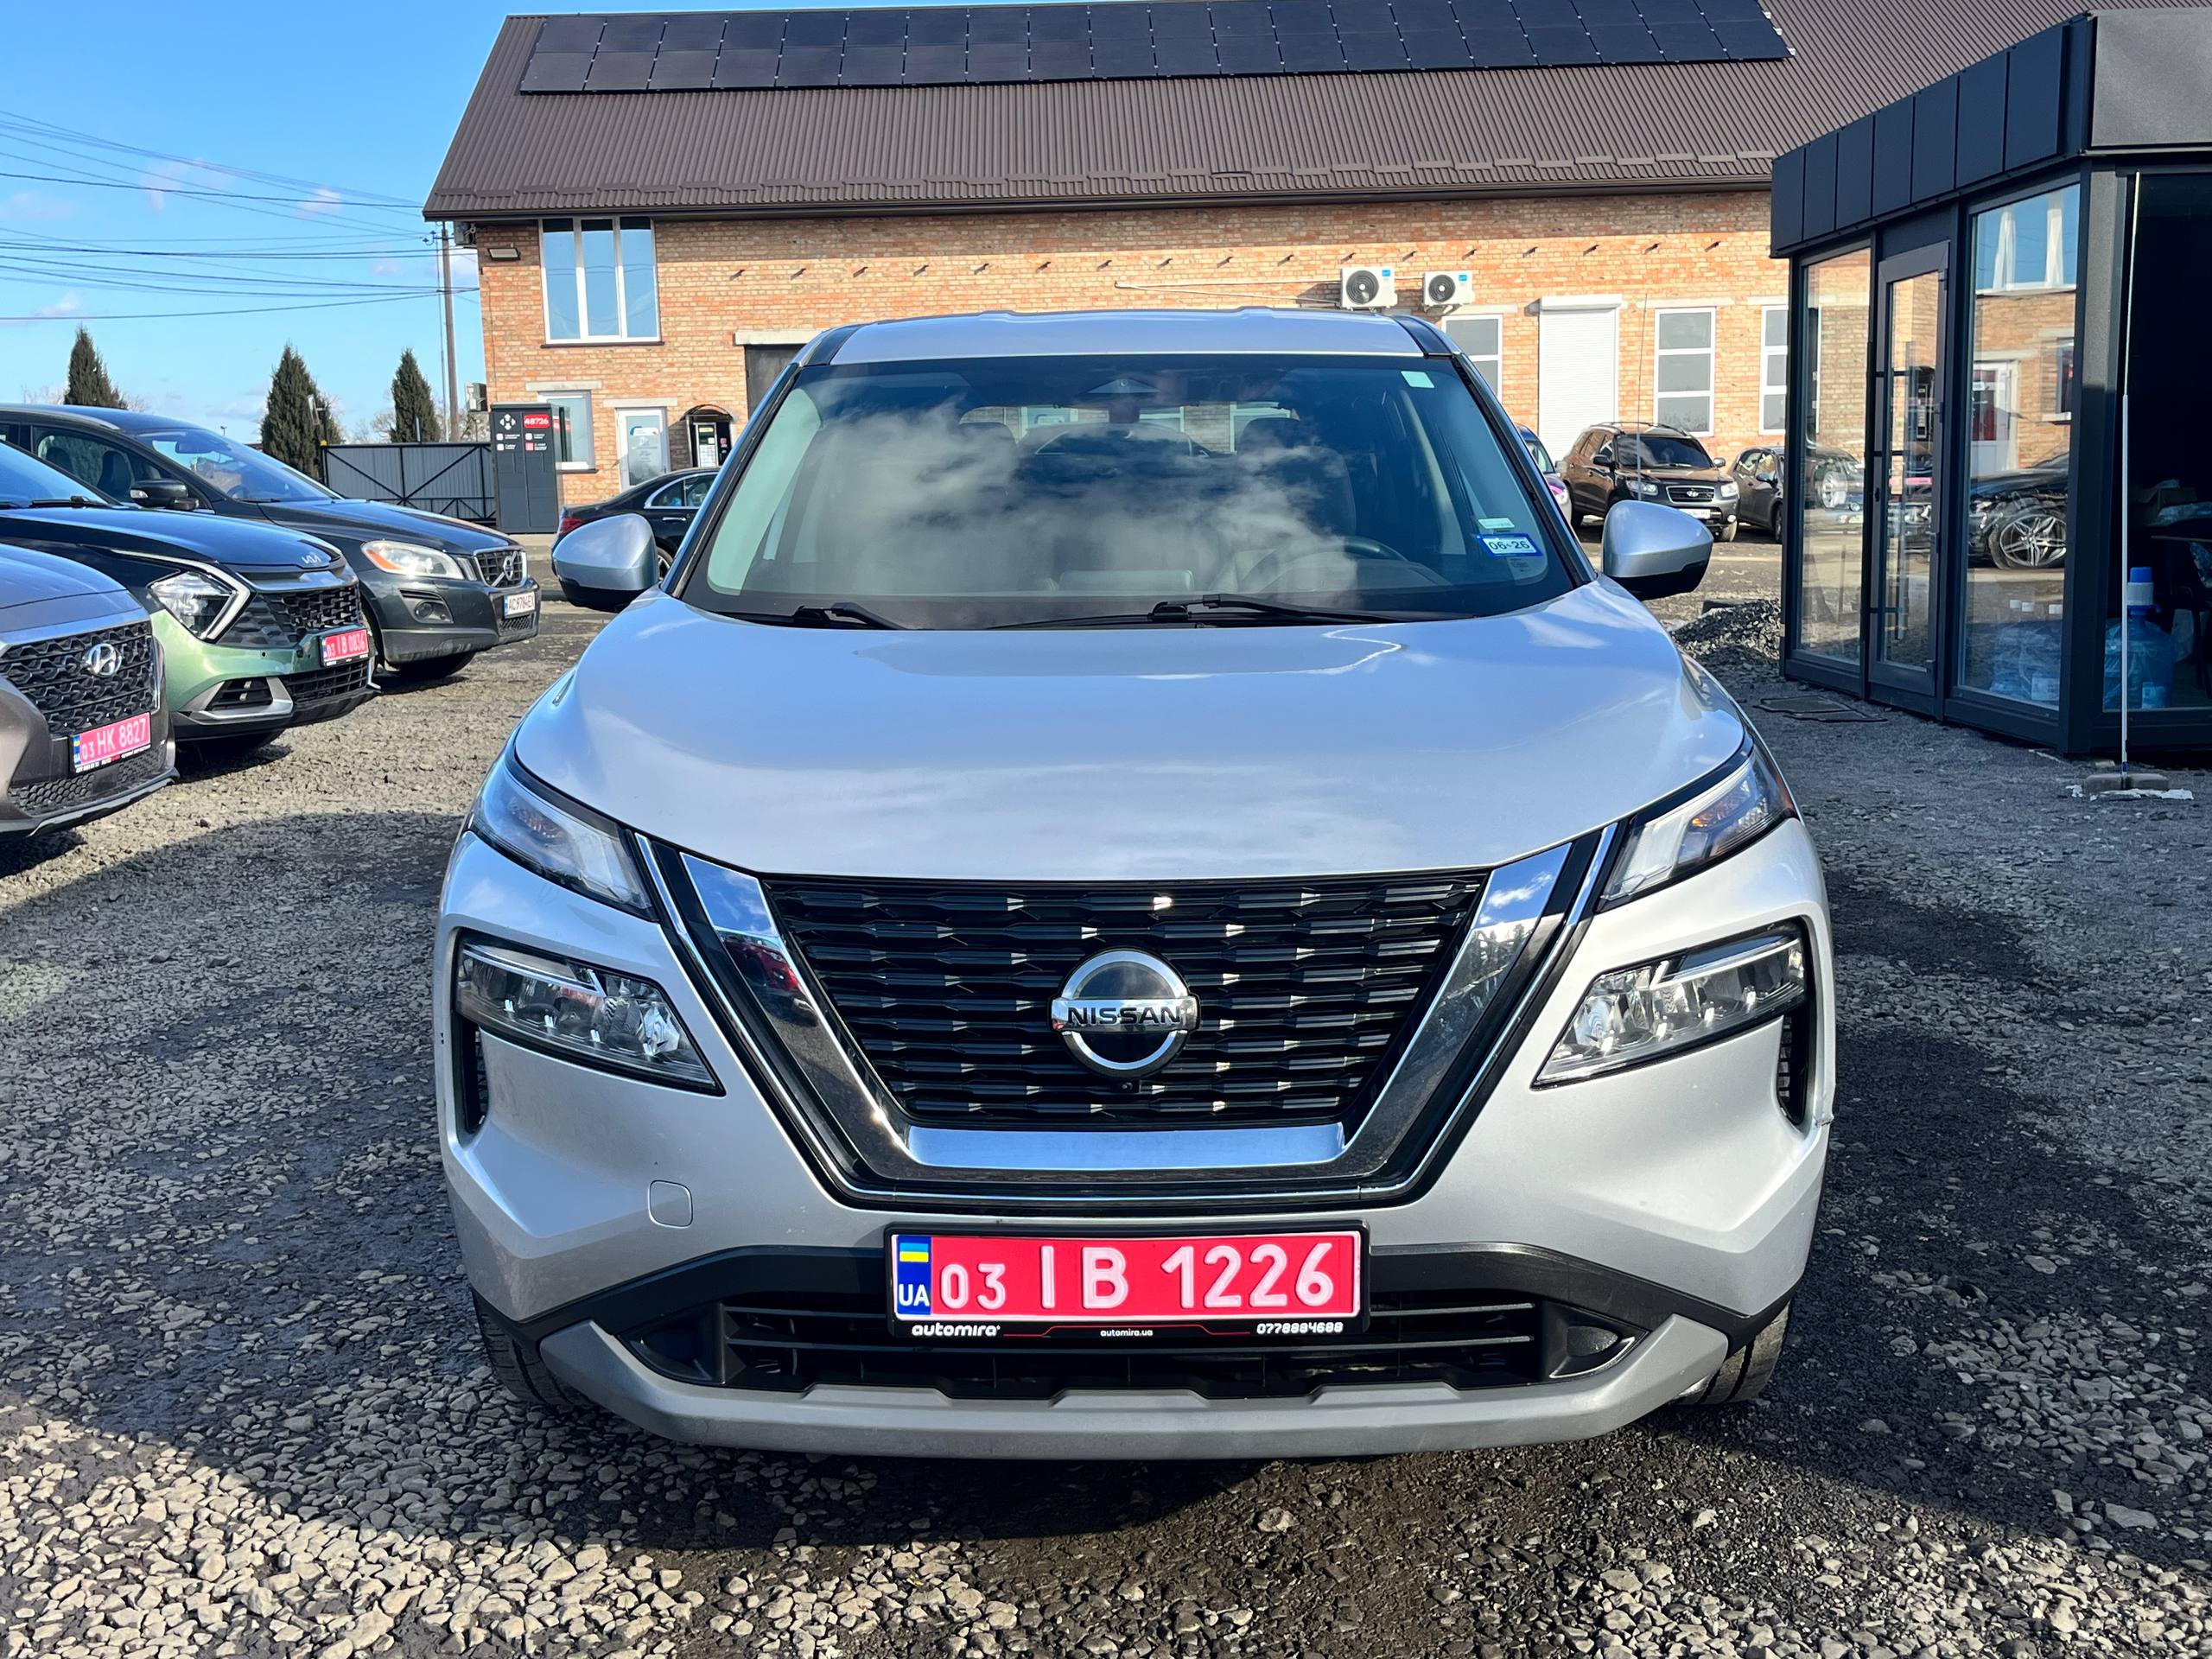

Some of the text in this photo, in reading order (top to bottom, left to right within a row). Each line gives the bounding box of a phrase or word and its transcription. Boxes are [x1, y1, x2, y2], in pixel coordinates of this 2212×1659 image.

[82, 741, 95, 760] 03
[97, 728, 116, 755] HK
[119, 717, 146, 747] 8827
[1068, 1007, 1181, 1025] NISSAN
[899, 1283, 931, 1306] UA
[941, 1263, 1006, 1309] 03
[1161, 1243, 1334, 1309] 1226
[1100, 1328, 1154, 1338] automira.ua
[1256, 1322, 1344, 1334] 0778884688
